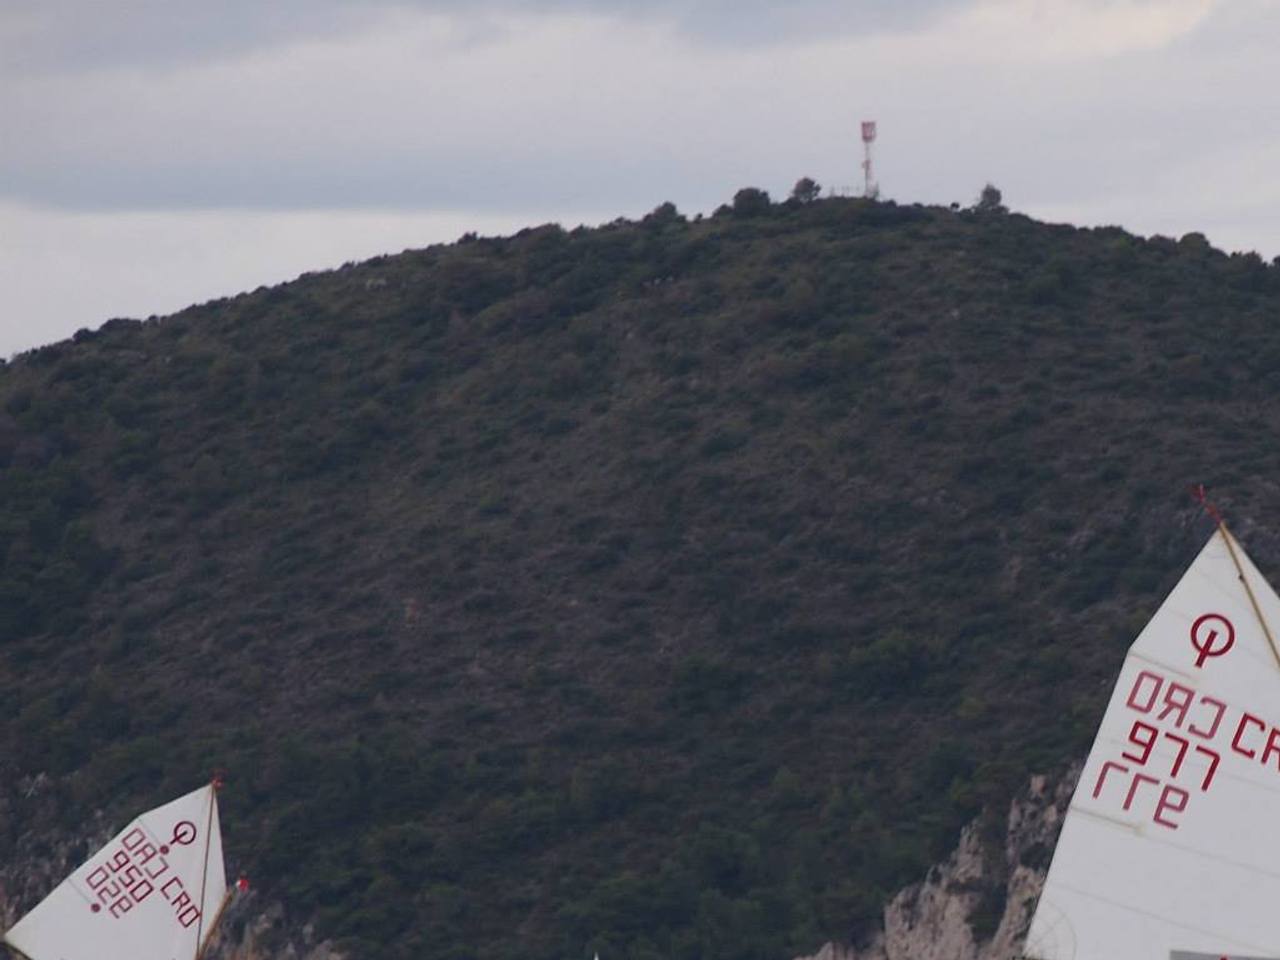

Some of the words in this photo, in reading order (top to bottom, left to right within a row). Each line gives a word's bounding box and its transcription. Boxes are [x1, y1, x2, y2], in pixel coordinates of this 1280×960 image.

[1122, 720, 1220, 792] 977
[105, 850, 154, 903] 950
[160, 877, 201, 929] CRO
